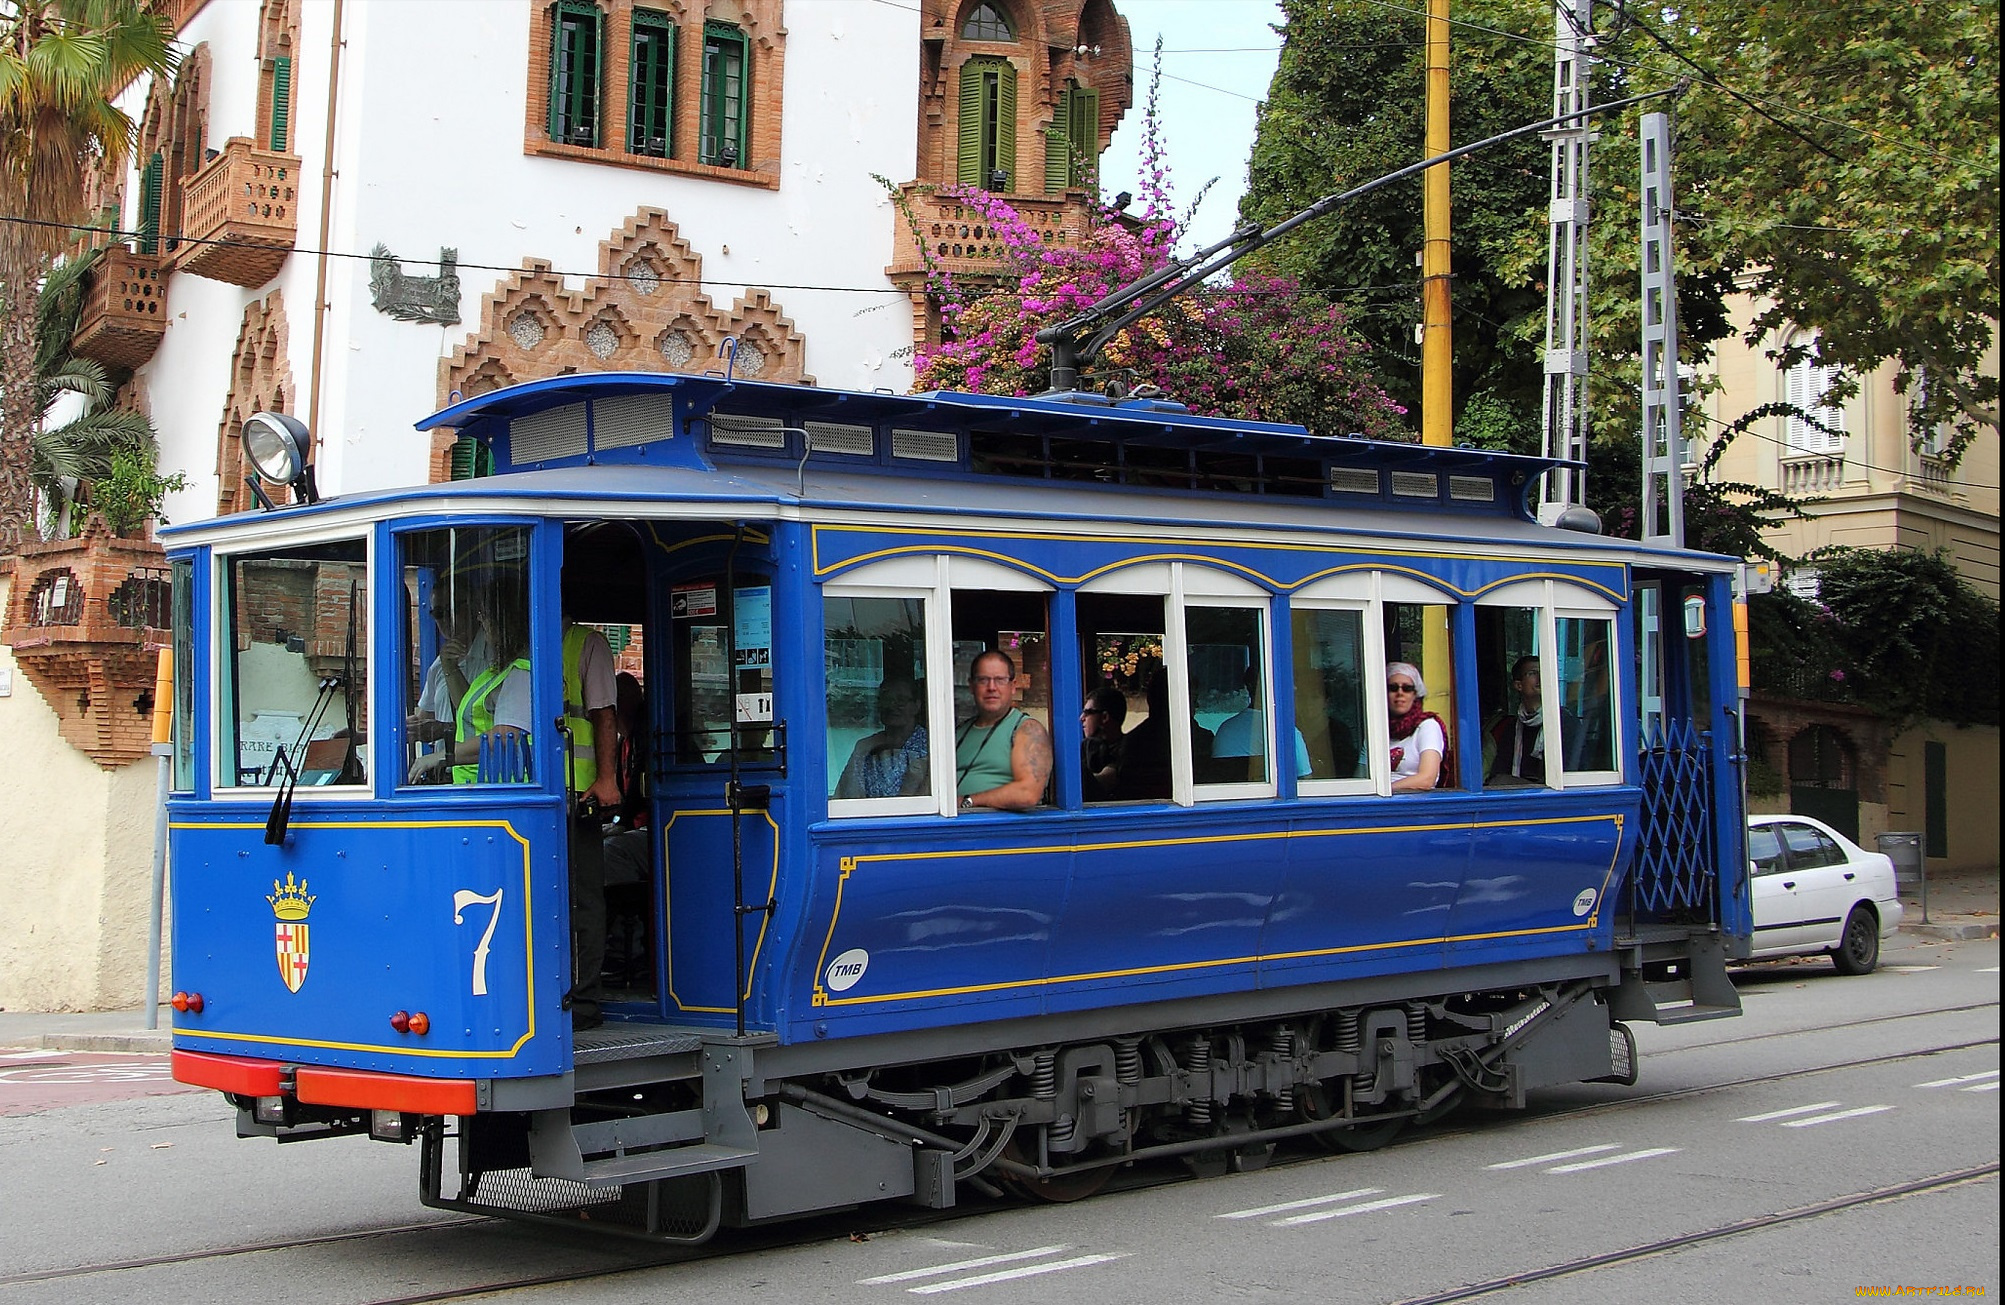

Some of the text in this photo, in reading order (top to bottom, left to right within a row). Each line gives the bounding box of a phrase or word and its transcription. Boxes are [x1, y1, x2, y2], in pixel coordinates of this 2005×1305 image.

[1578, 898, 1593, 907] TMB
[453, 887, 503, 995] 7
[835, 963, 862, 977] TMB
